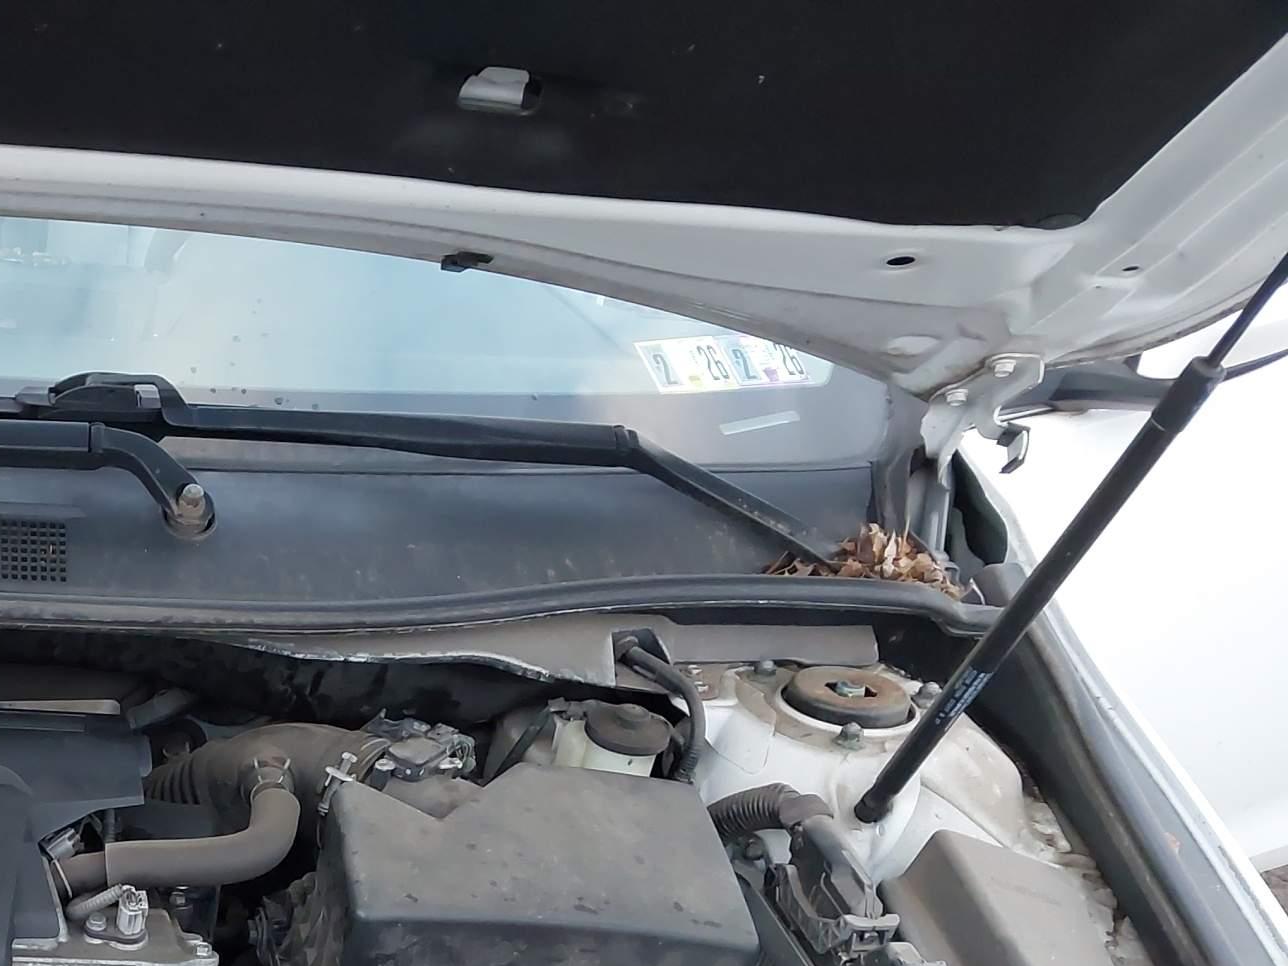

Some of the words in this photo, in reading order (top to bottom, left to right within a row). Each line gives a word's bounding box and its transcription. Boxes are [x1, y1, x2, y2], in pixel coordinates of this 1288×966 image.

[652, 353, 679, 385] 2
[696, 344, 730, 380] 26
[732, 348, 758, 380] 2
[772, 342, 805, 376] 26
